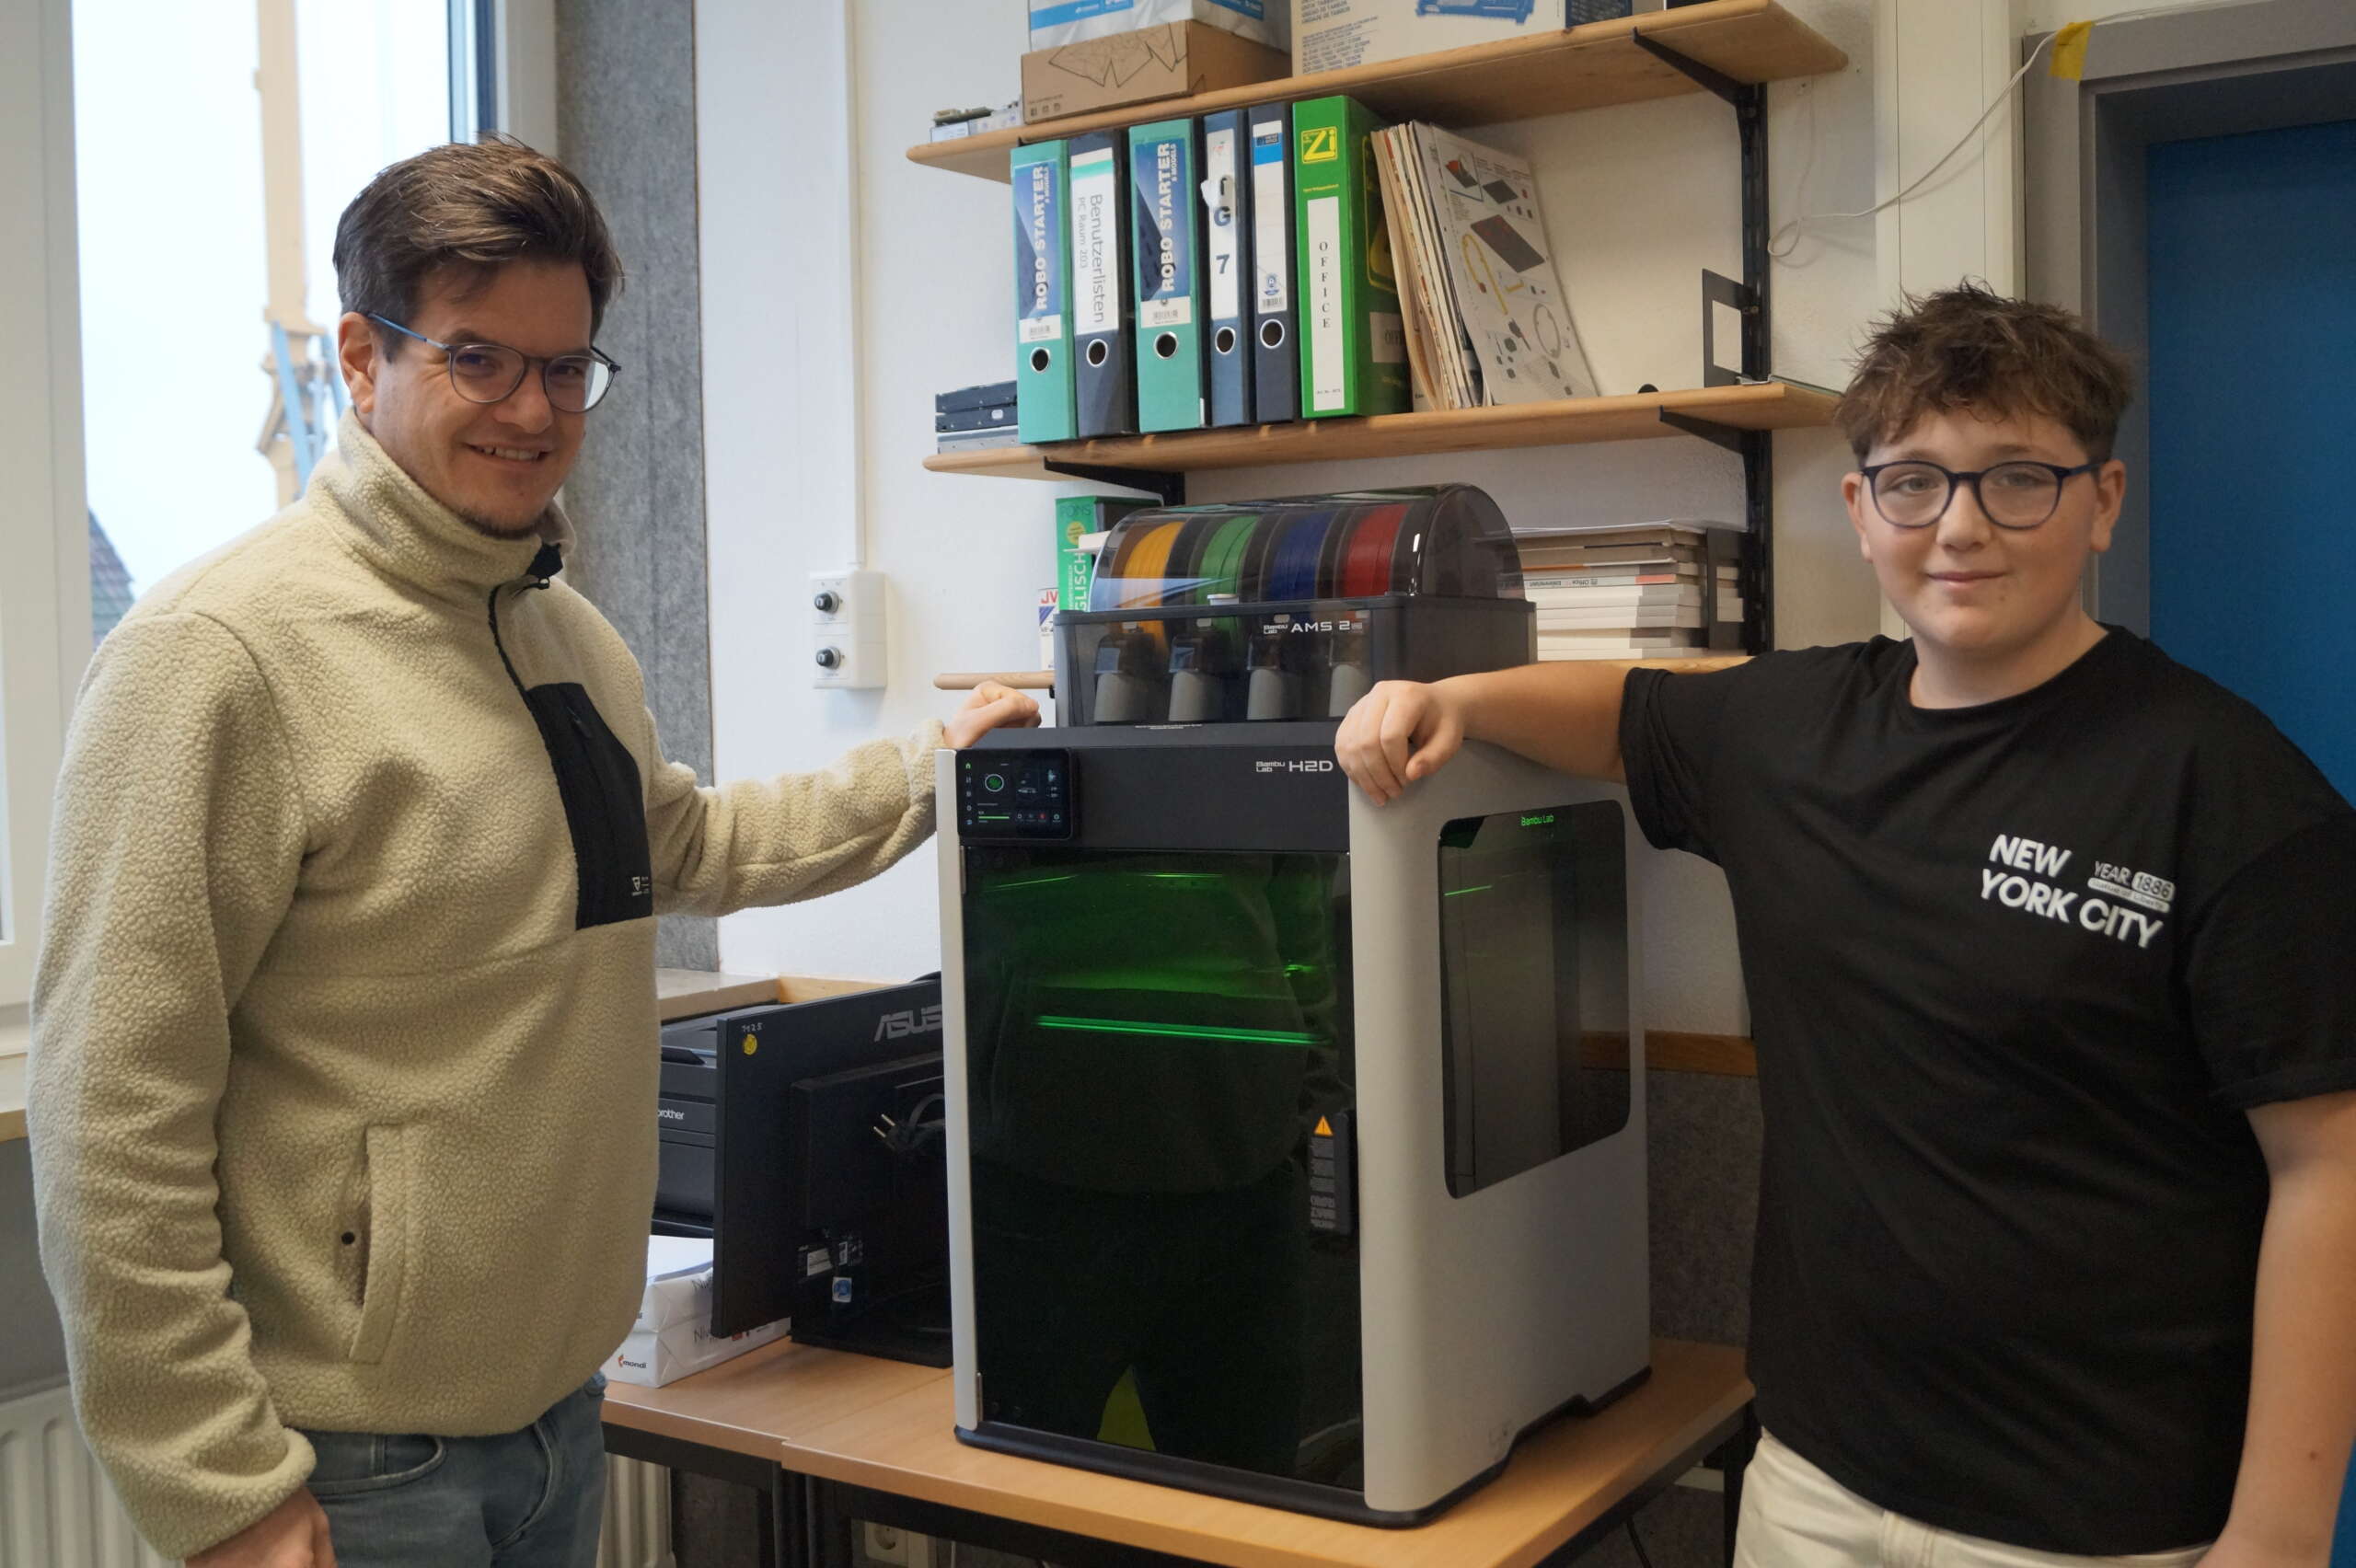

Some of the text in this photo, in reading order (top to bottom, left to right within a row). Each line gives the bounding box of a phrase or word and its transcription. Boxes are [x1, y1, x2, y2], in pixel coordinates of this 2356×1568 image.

[1078, 197, 1087, 212] PC
[1157, 143, 1175, 292] ROBO STARTER
[1033, 166, 1048, 310] ROBO STARTER
[1079, 213, 1088, 247] Raum
[1090, 194, 1106, 323] Benutzerlisten
[1215, 254, 1230, 274] 7
[1319, 241, 1331, 329] OFFICE
[1040, 590, 1057, 604] JV
[1075, 552, 1087, 611] GLISCH
[1290, 622, 1333, 633] AMS
[1339, 620, 1350, 630] 2
[1288, 760, 1334, 772] H2D
[1989, 834, 2073, 878] NEW
[2136, 874, 2171, 899] 1886
[1981, 869, 2078, 923] YORK
[2079, 898, 2164, 949] CITY
[874, 1005, 943, 1042] ASUS
[623, 1359, 647, 1369] mondi
